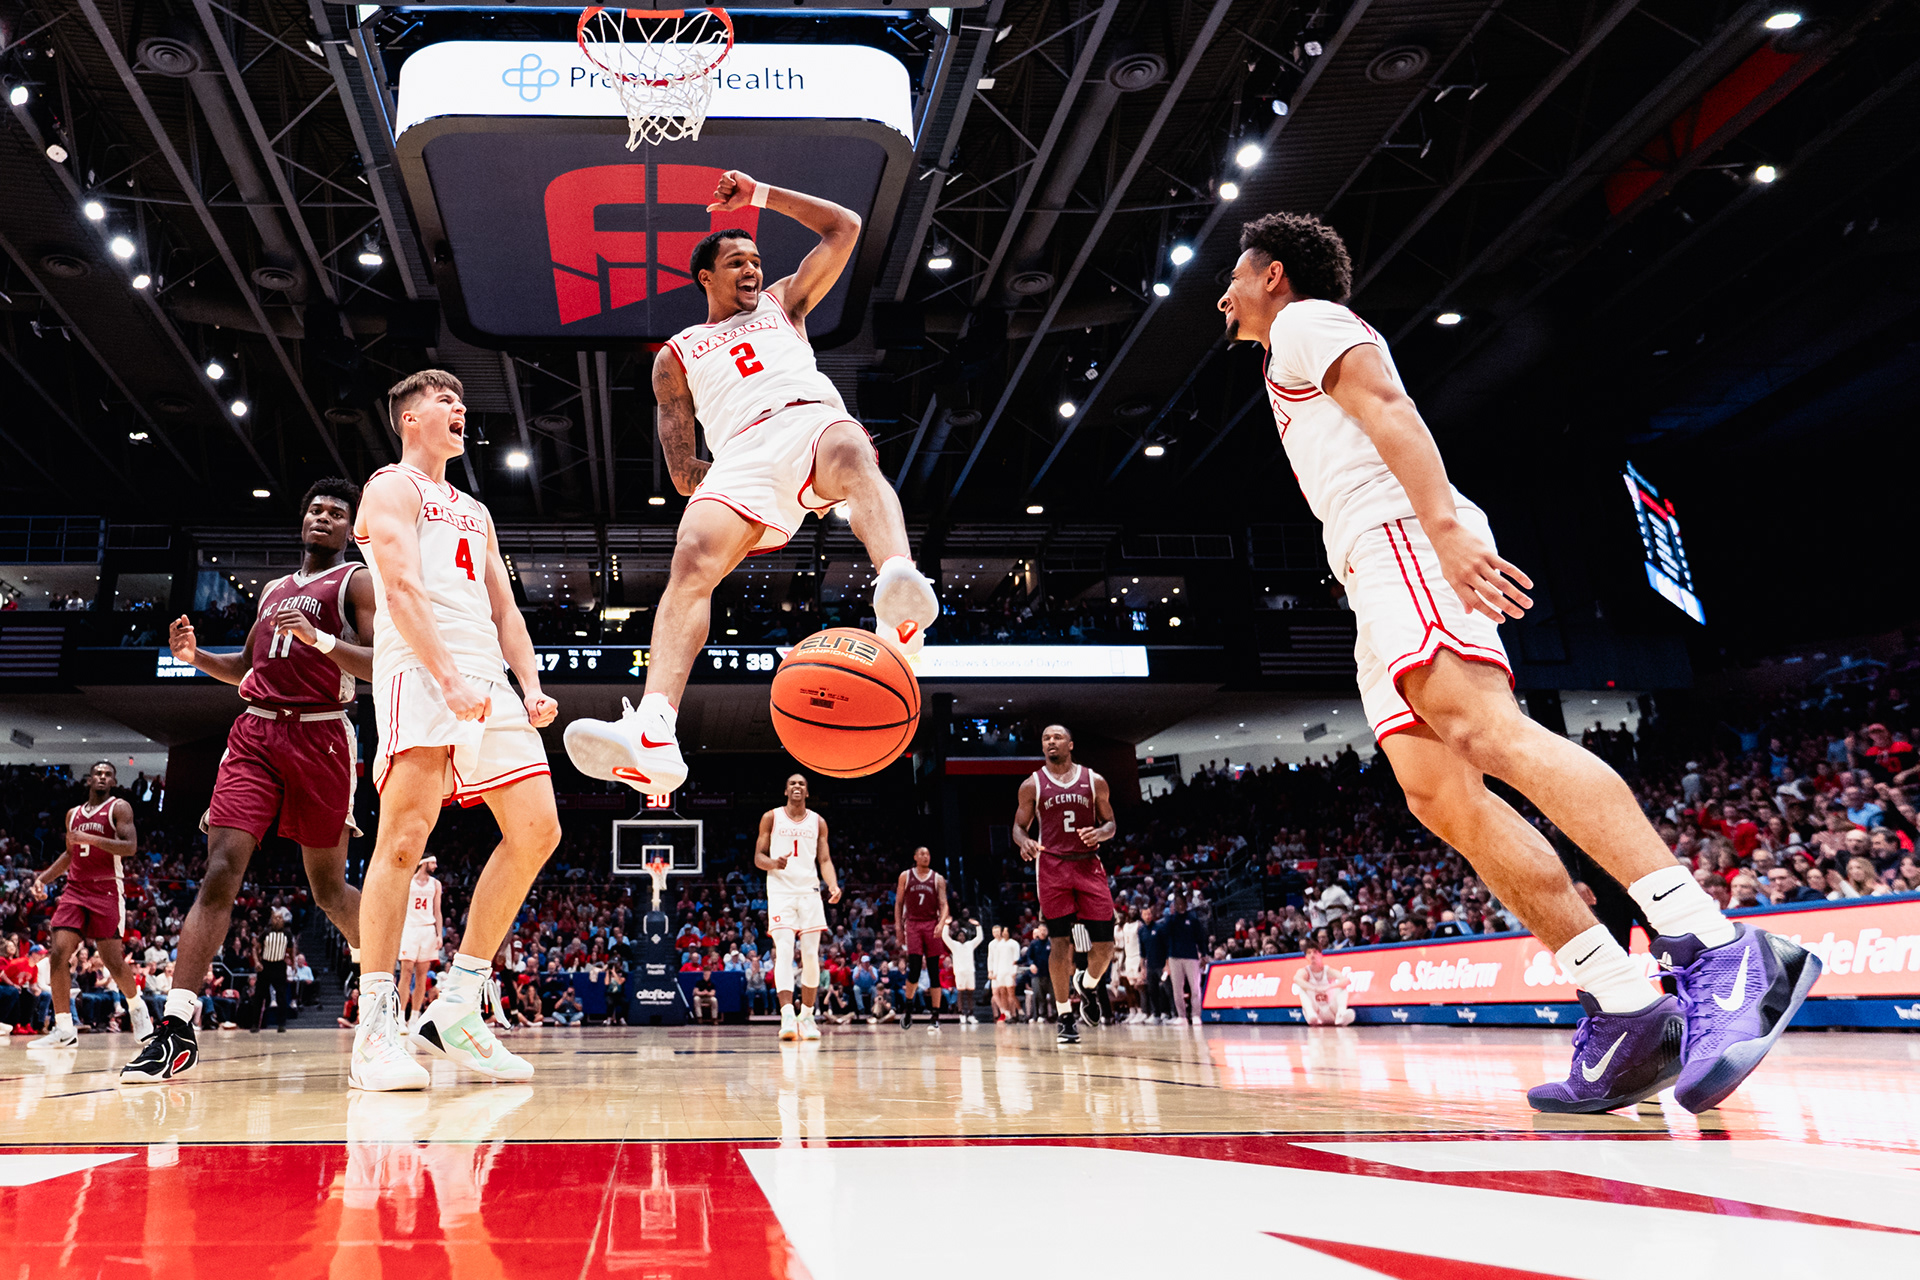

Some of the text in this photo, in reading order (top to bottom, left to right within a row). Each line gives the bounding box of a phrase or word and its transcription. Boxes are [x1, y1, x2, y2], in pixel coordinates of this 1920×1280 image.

[570, 67, 804, 89] Prem Health
[692, 315, 778, 359] DAYTON
[729, 342, 764, 378] 2
[423, 502, 487, 538] DAYTON
[455, 538, 476, 581] 4
[260, 595, 321, 622] NC CENTRAL
[268, 624, 293, 658] 11
[800, 635, 879, 662] ELITE
[535, 653, 560, 672] 17
[569, 657, 597, 669] 3 6
[713, 656, 739, 669] 6 4
[746, 653, 774, 671] 39
[796, 648, 874, 667] CHAMPIONSHIP
[932, 658, 980, 667] Windows
[991, 658, 1021, 667] Doors
[1037, 658, 1073, 669] Dayton
[157, 667, 197, 677] DAYTON
[79, 822, 105, 834] CENTRAL
[1063, 810, 1075, 832] 2
[779, 828, 814, 839] DAYTON
[793, 840, 798, 857] 1
[414, 897, 428, 911] 24
[918, 893, 925, 905] 7
